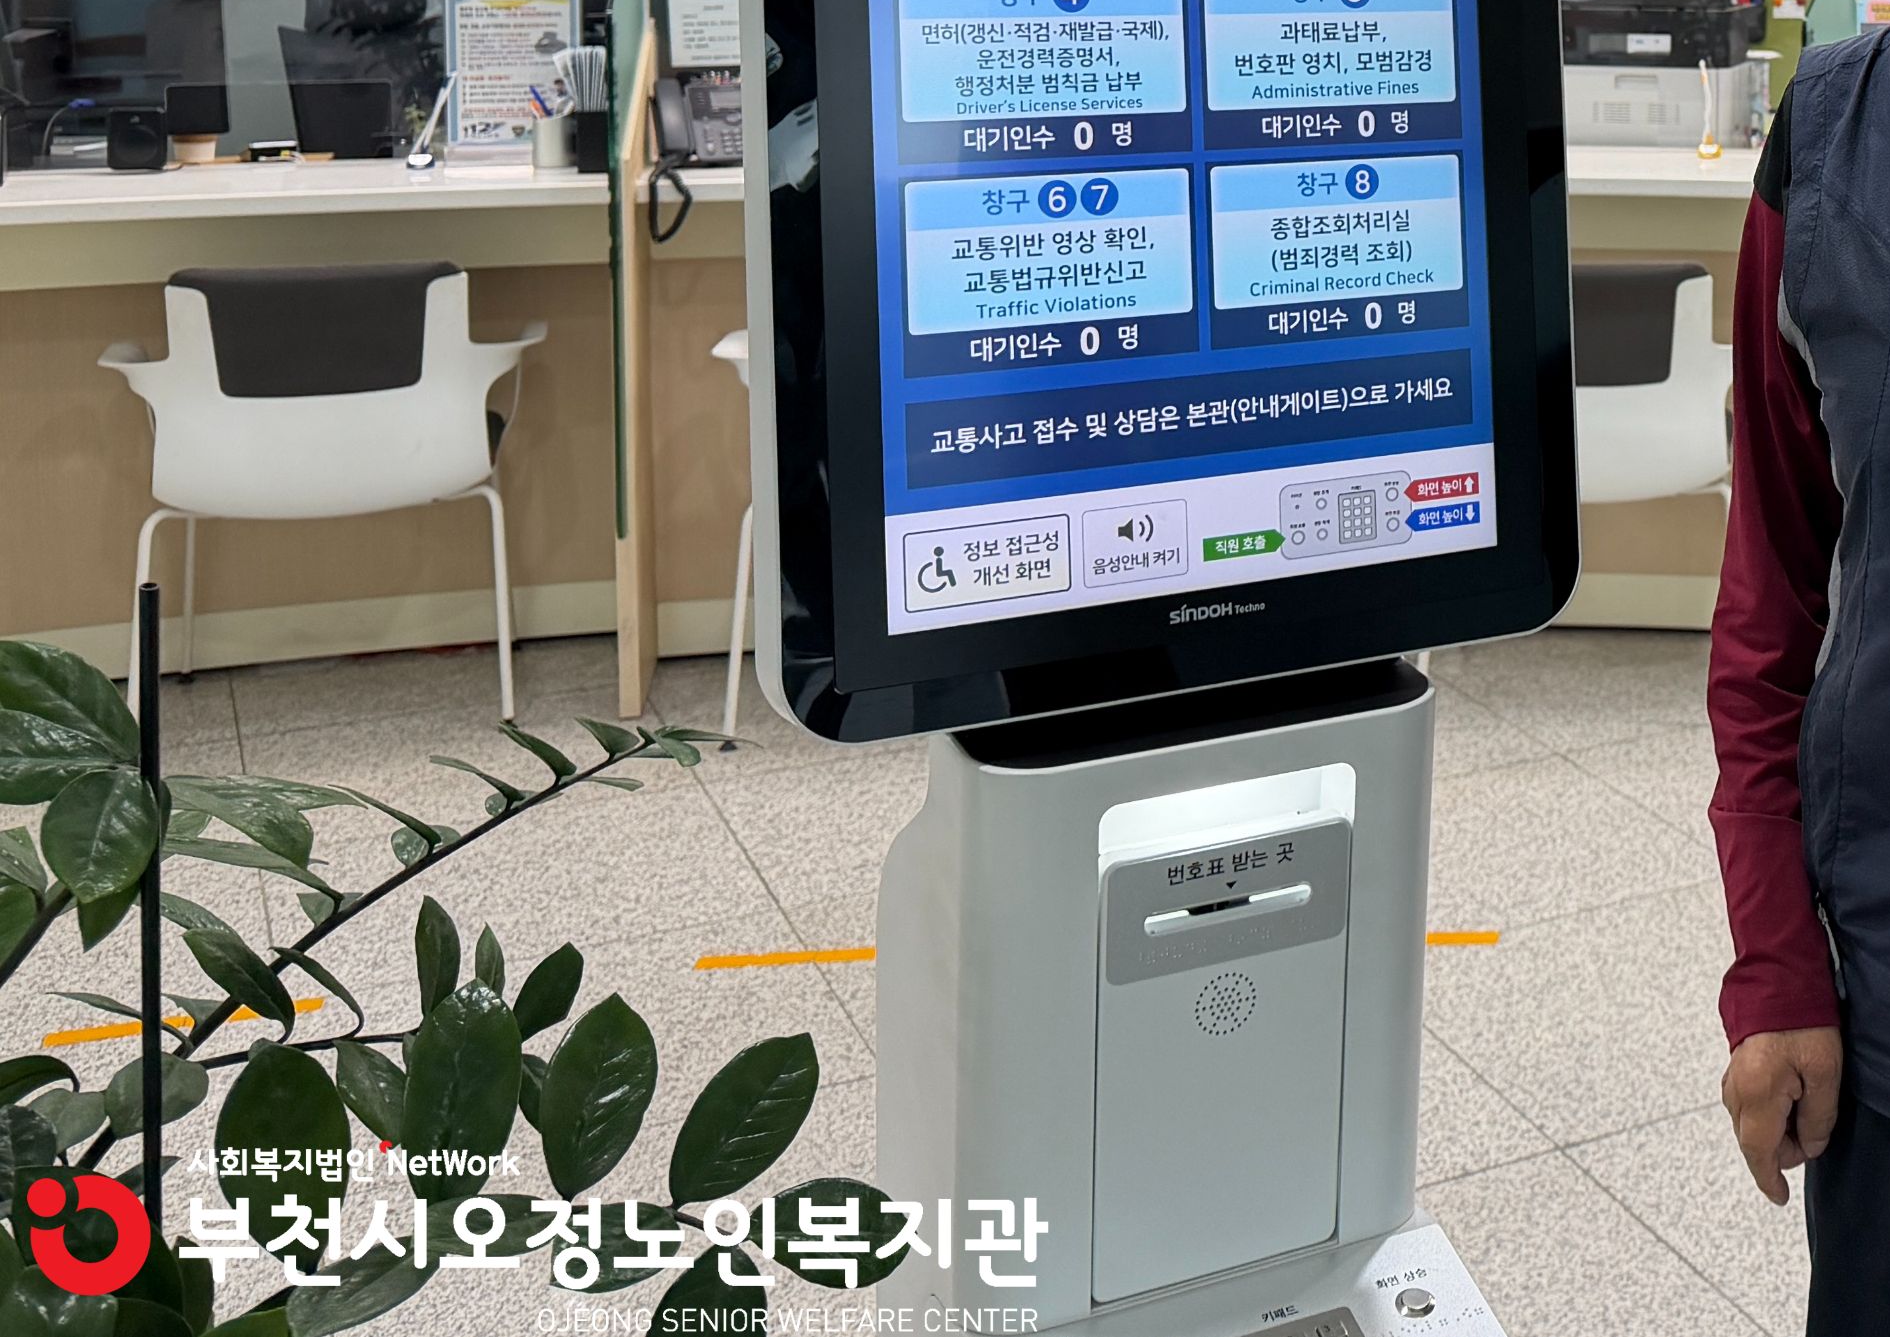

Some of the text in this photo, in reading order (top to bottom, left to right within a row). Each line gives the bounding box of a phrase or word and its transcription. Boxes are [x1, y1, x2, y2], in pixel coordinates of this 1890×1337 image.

[1280, 21, 1386, 44] 과태료납부,
[976, 47, 1120, 70] 운전경력증명서,
[1235, 50, 1431, 76] 번호판 영치, 모범감경
[955, 72, 1142, 97] 행정처분 범칙금 납부
[1252, 81, 1419, 99] Administrative Fines
[1020, 99, 1076, 112] License
[1082, 97, 1142, 110] Services
[1297, 172, 1338, 196] 창구
[1271, 210, 1410, 240] 종합조회처리실
[952, 226, 1154, 260] 교통위반 영상 확인,
[1271, 240, 1412, 272] (범죄경력 조회)
[964, 260, 1147, 293] 교통법규위반신고
[1250, 269, 1434, 297] Criminal Record Check
[976, 294, 1136, 319] Traffic Violations
[1268, 300, 1416, 335] 대기인수 0 명
[930, 377, 1453, 454] 교통사고 접수 및 상담은 본관(안내게이트)으로 가세요
[1417, 478, 1462, 496] 화면 높이
[964, 530, 1060, 561] 정보 접근성
[1215, 534, 1267, 553] 직원 호출
[973, 559, 1052, 587] 개선 화면
[1092, 547, 1181, 575] 음성안내 켜기
[1235, 603, 1265, 614] Techno
[1168, 842, 1295, 886] 번호표 받는 곳
